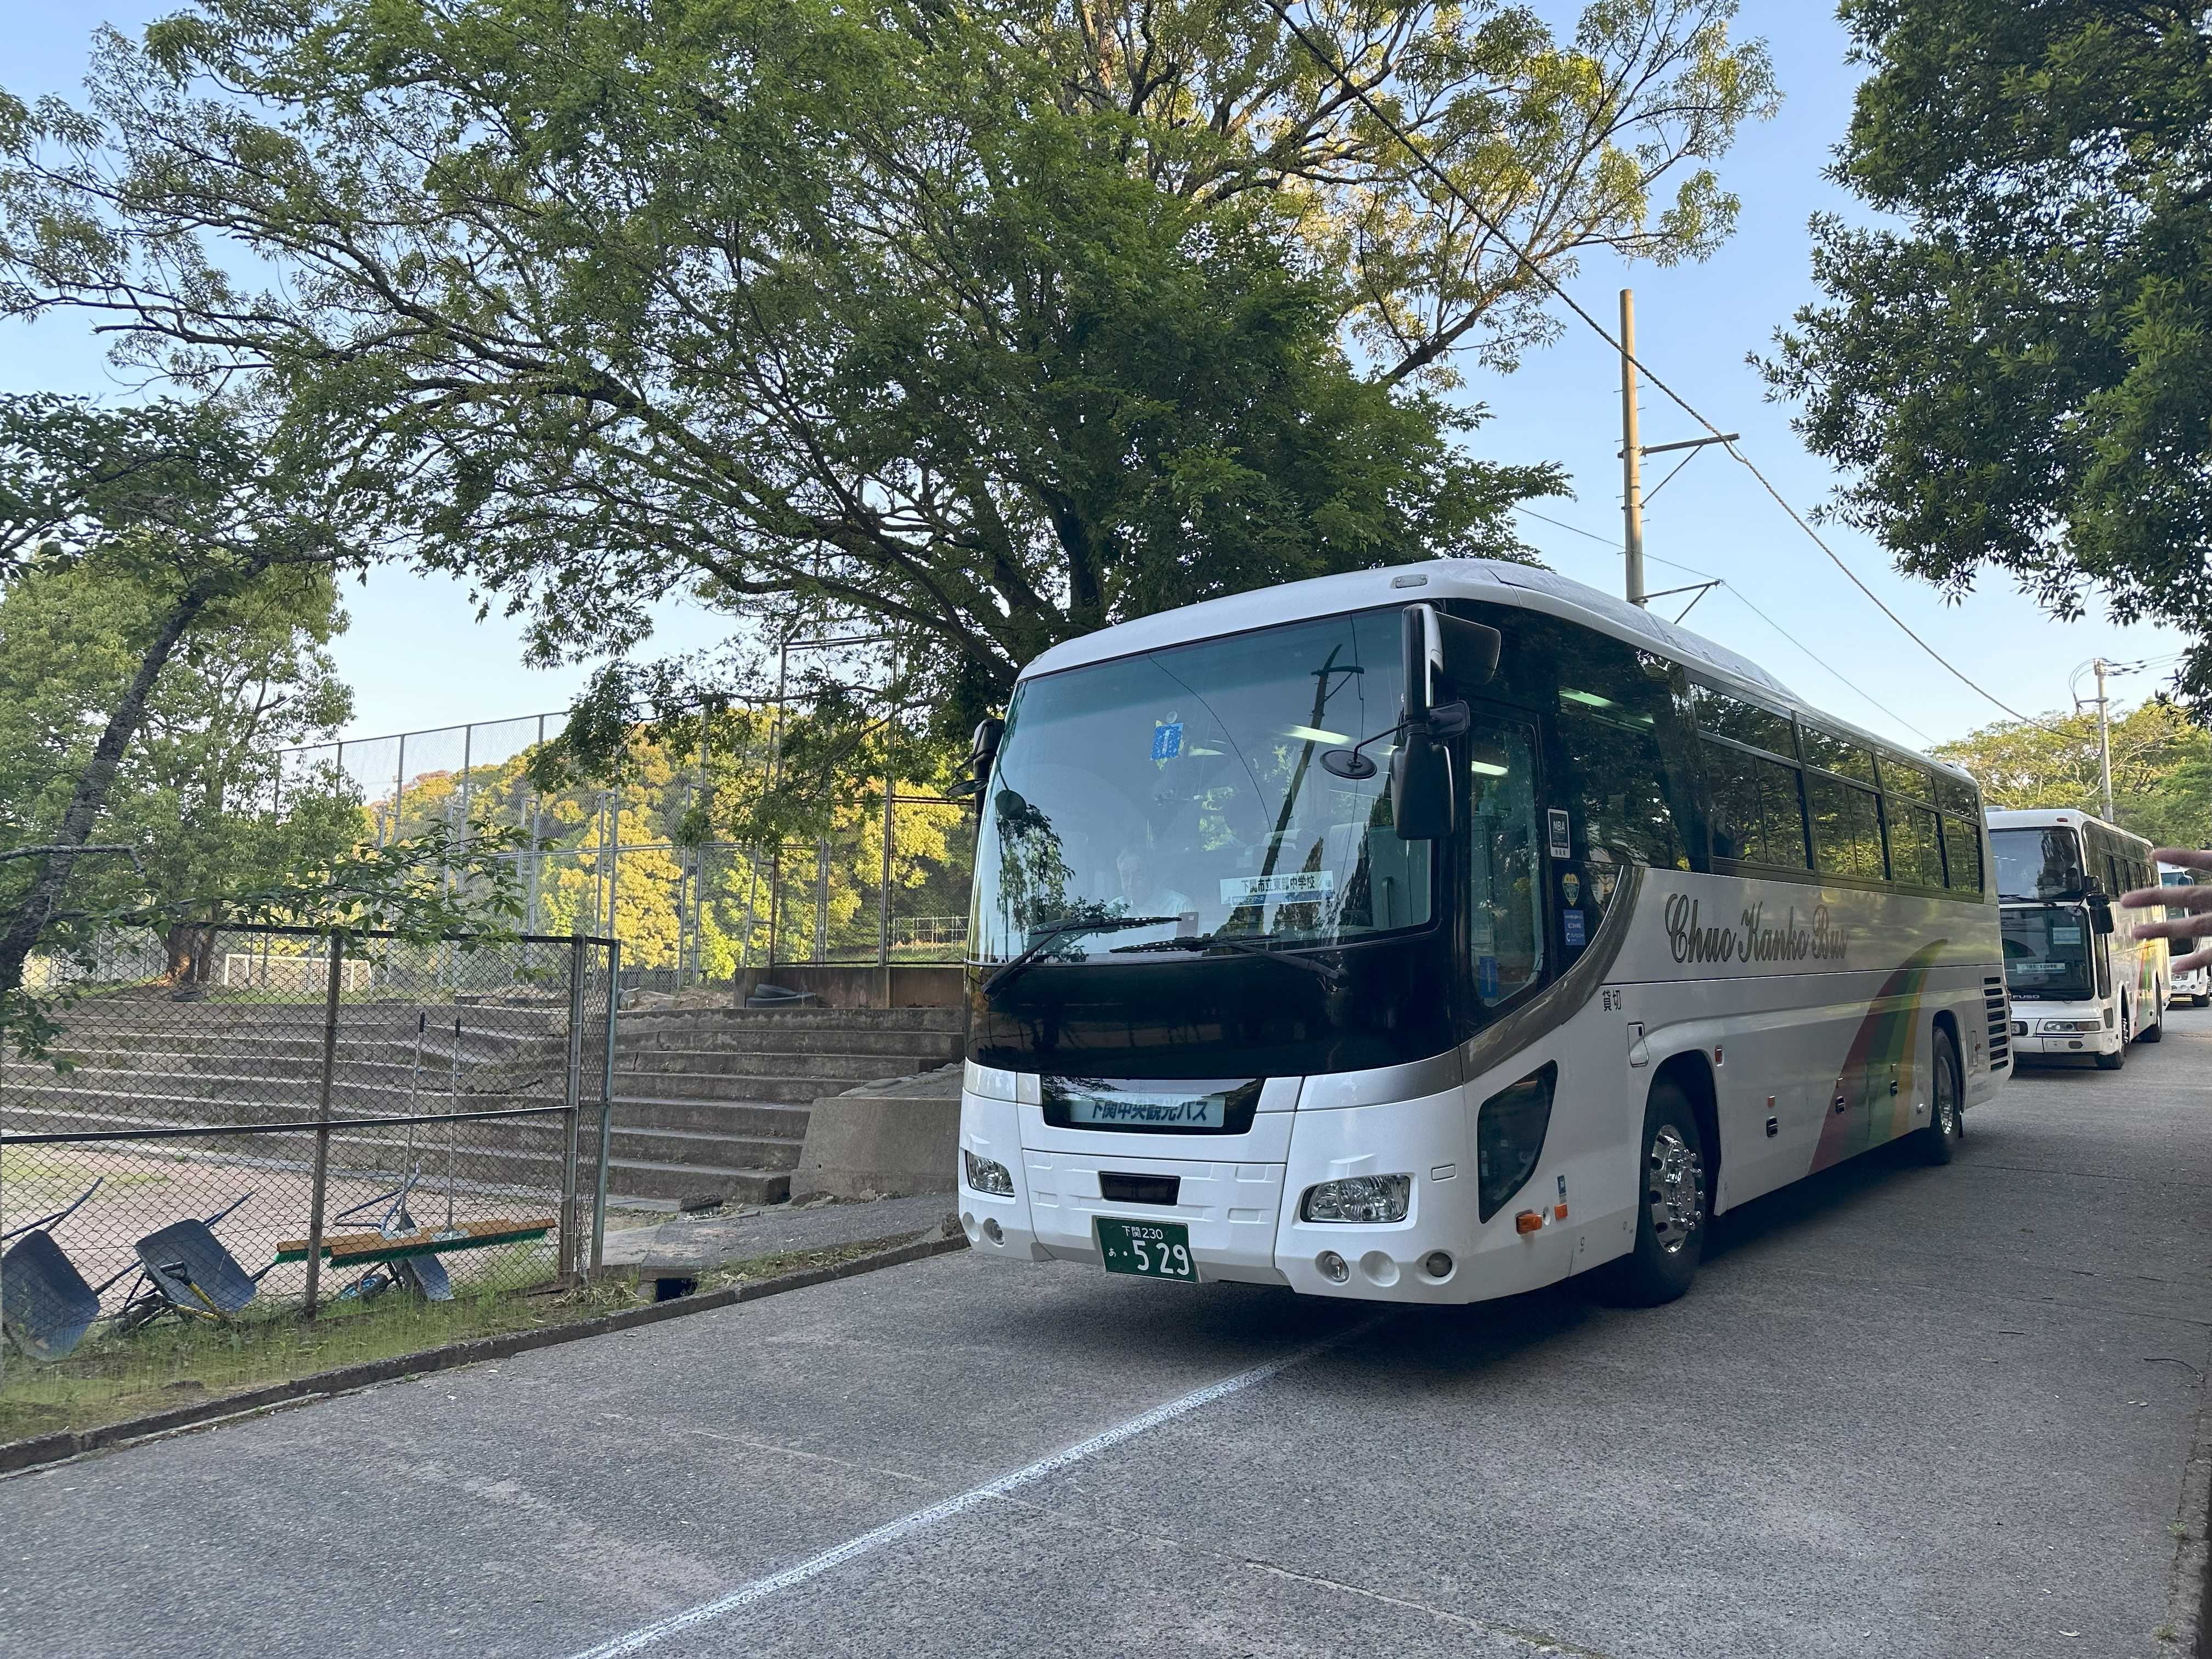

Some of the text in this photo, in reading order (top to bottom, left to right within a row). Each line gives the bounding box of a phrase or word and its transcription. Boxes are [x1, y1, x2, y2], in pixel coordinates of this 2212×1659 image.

[1553, 820, 1565, 831] NBA
[1241, 874, 1315, 893] 下関市立東部中学校
[1665, 894, 1849, 963] Chuo Kanko Bus
[1602, 990, 1621, 1011] 貸切
[1108, 1246, 1116, 1257] あ
